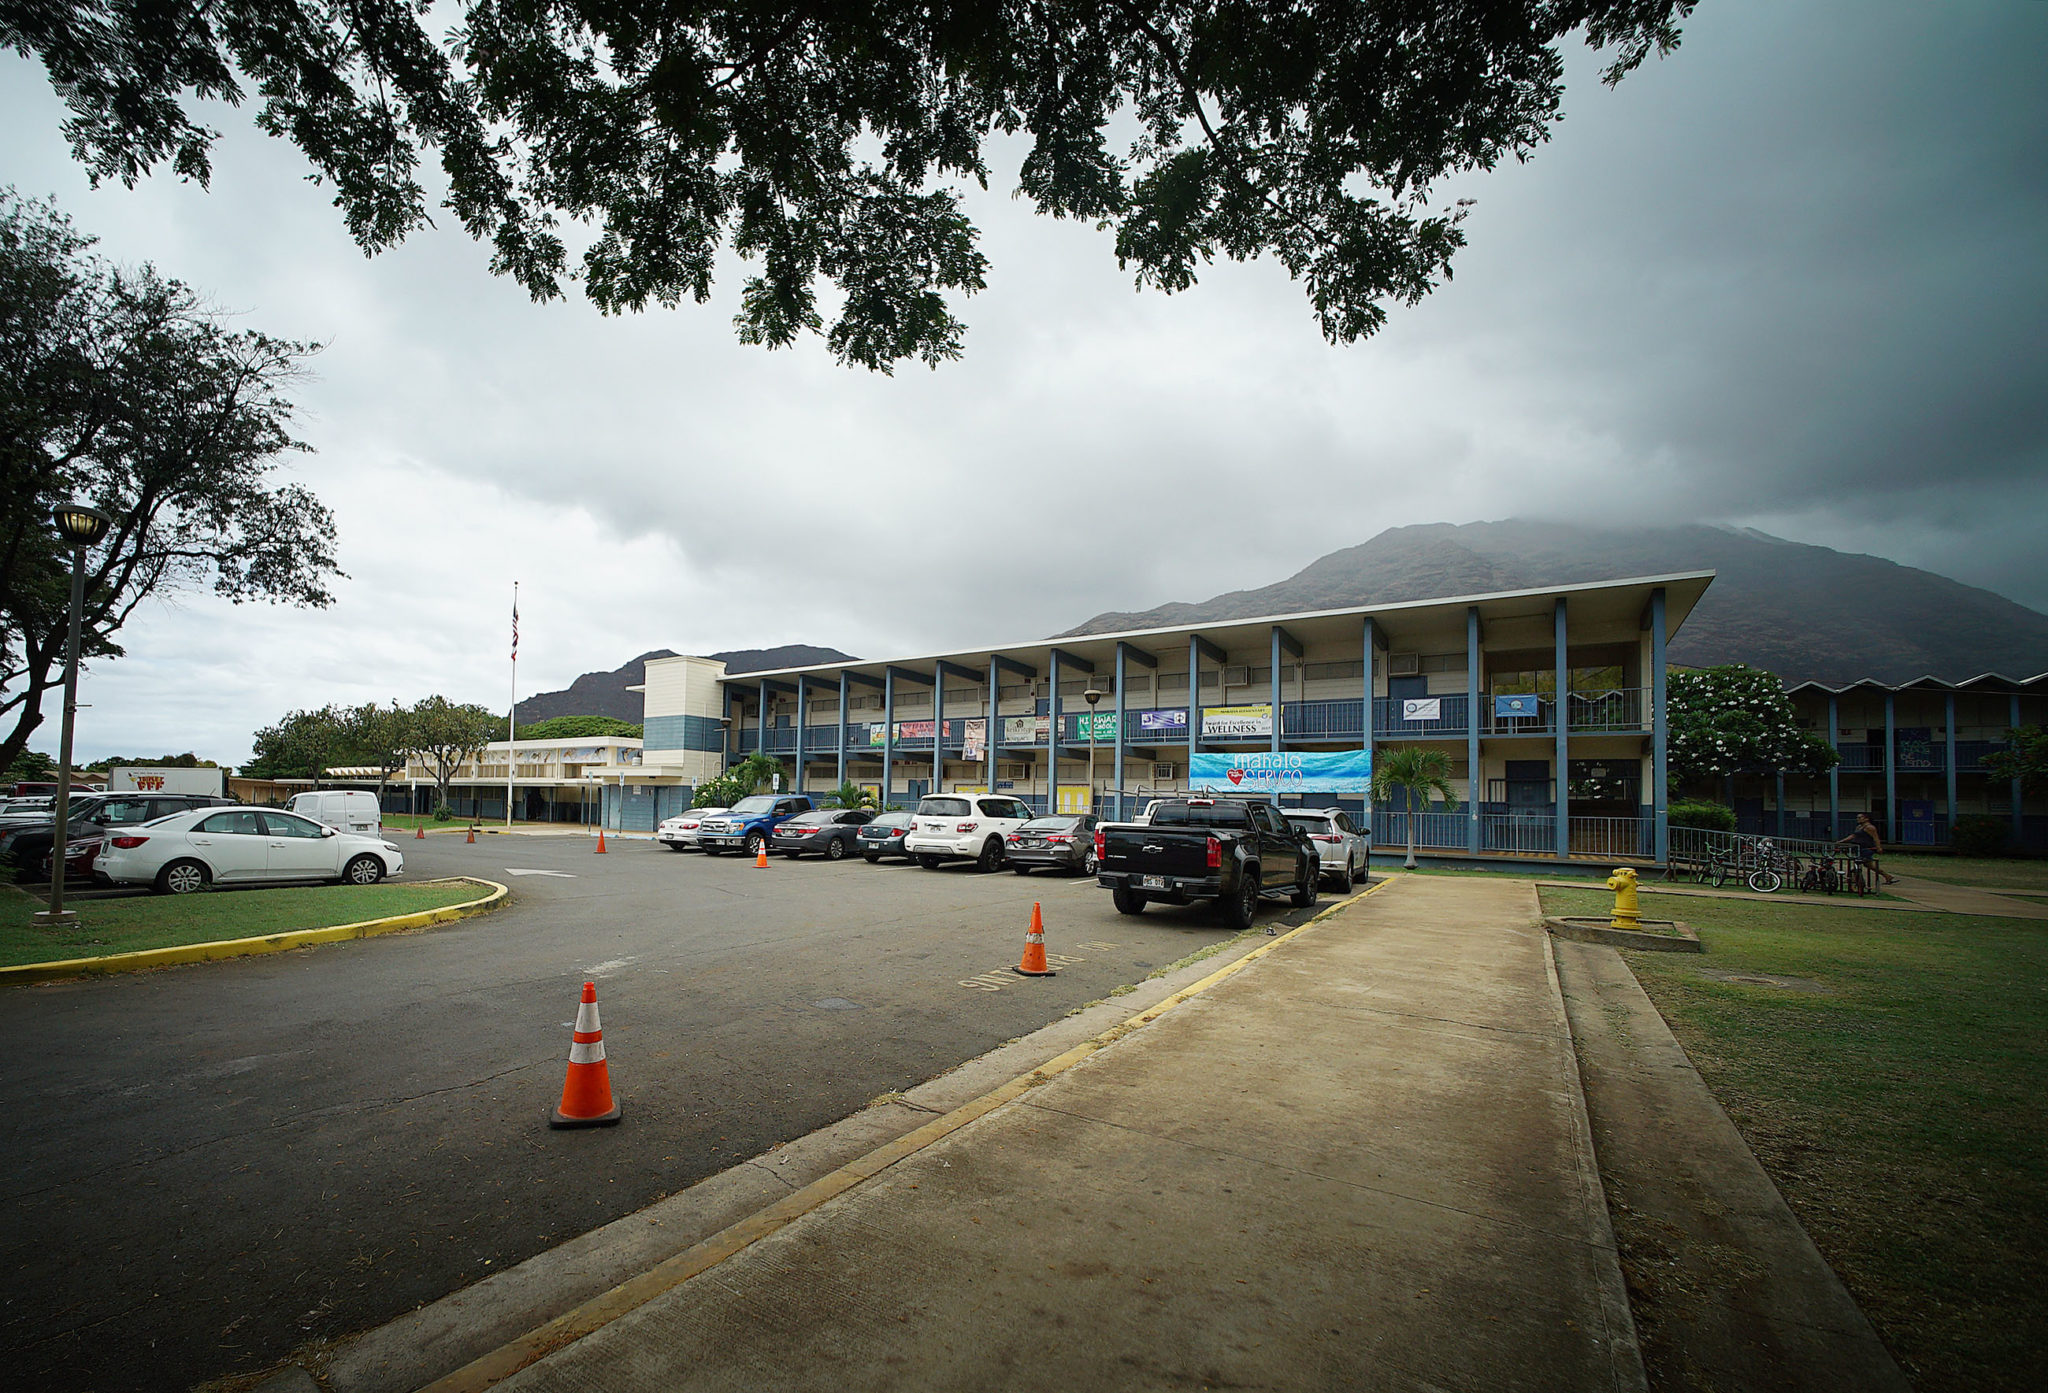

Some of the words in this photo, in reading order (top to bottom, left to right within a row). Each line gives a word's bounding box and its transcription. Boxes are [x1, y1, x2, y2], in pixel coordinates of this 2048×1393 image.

[1207, 724, 1257, 734] WELLNESS
[1234, 752, 1302, 769] mahalo
[1244, 768, 1303, 788] SERVCO
[957, 953, 1087, 992] PARING
